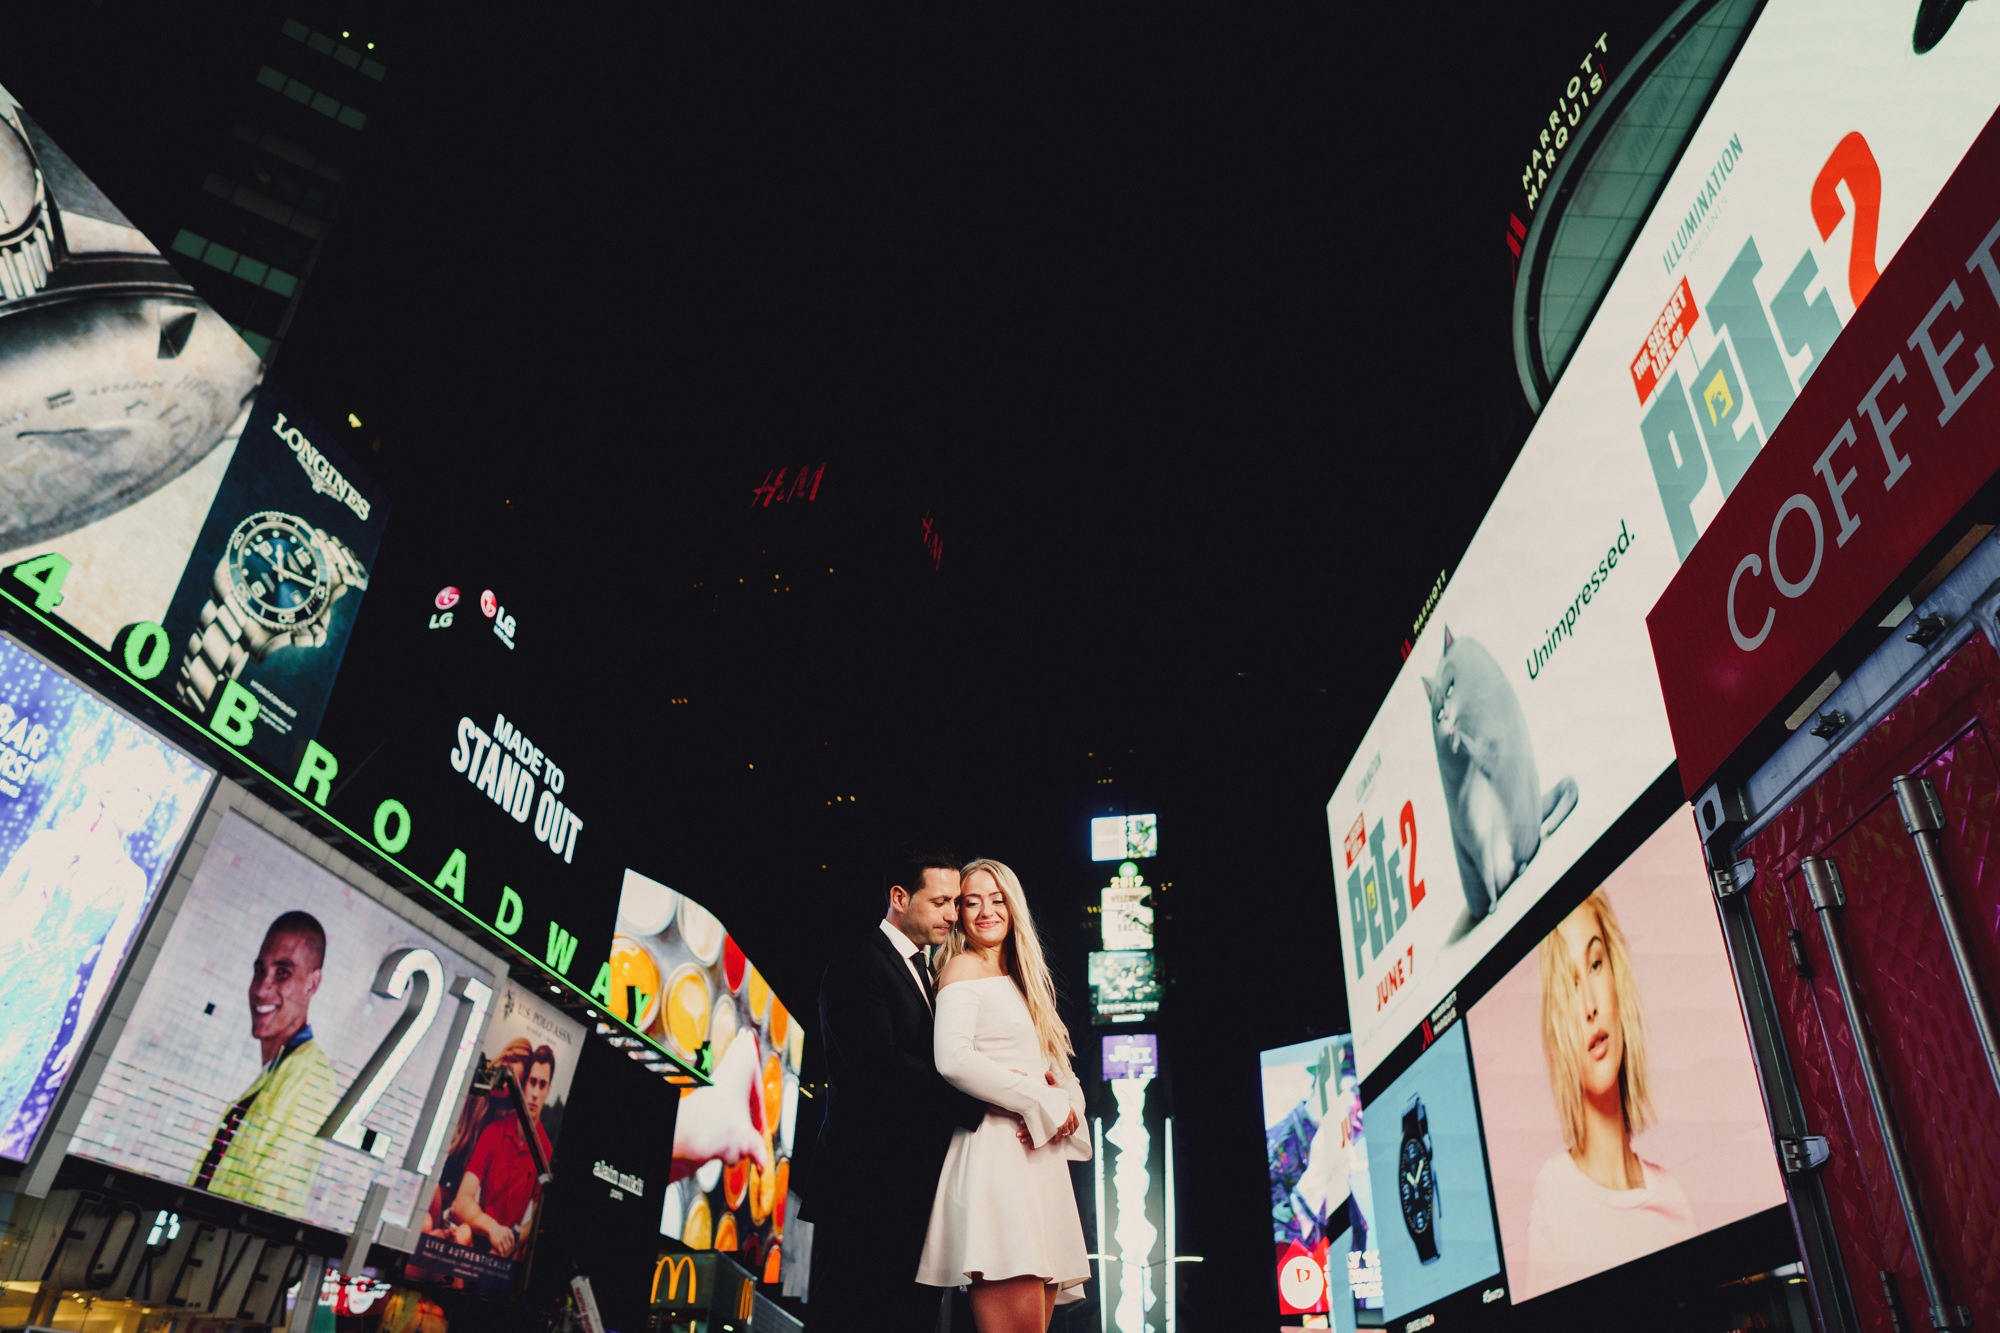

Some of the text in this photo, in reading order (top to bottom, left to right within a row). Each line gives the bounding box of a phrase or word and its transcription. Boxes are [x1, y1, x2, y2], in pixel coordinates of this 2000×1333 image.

[1522, 32, 1608, 190] MARRIOTT
[1527, 73, 1603, 210] MARQUIS
[1662, 132, 1744, 276] ILLUMINATION
[1810, 130, 1882, 311] 2
[1632, 284, 1687, 381] THE SECRET
[1651, 322, 1684, 381] LIFE OF
[272, 412, 371, 521] LONGINES
[751, 461, 828, 508] H&M
[428, 611, 454, 629] LG
[495, 605, 517, 639] LG
[1527, 518, 1636, 682] Unimpressed.
[450, 716, 584, 864] STAND OUT
[493, 713, 565, 795] MADE TO
[210, 680, 651, 1029] BROADWAY
[1110, 875, 1144, 889] 2019
[1399, 800, 1426, 911] 2
[1376, 944, 1414, 1013] JUNE 7
[326, 948, 494, 1176] 21
[42, 1190, 307, 1327] FOREVER
[425, 1239, 446, 1252] LIVE
[448, 1247, 512, 1272] AUTHENTICALLY
